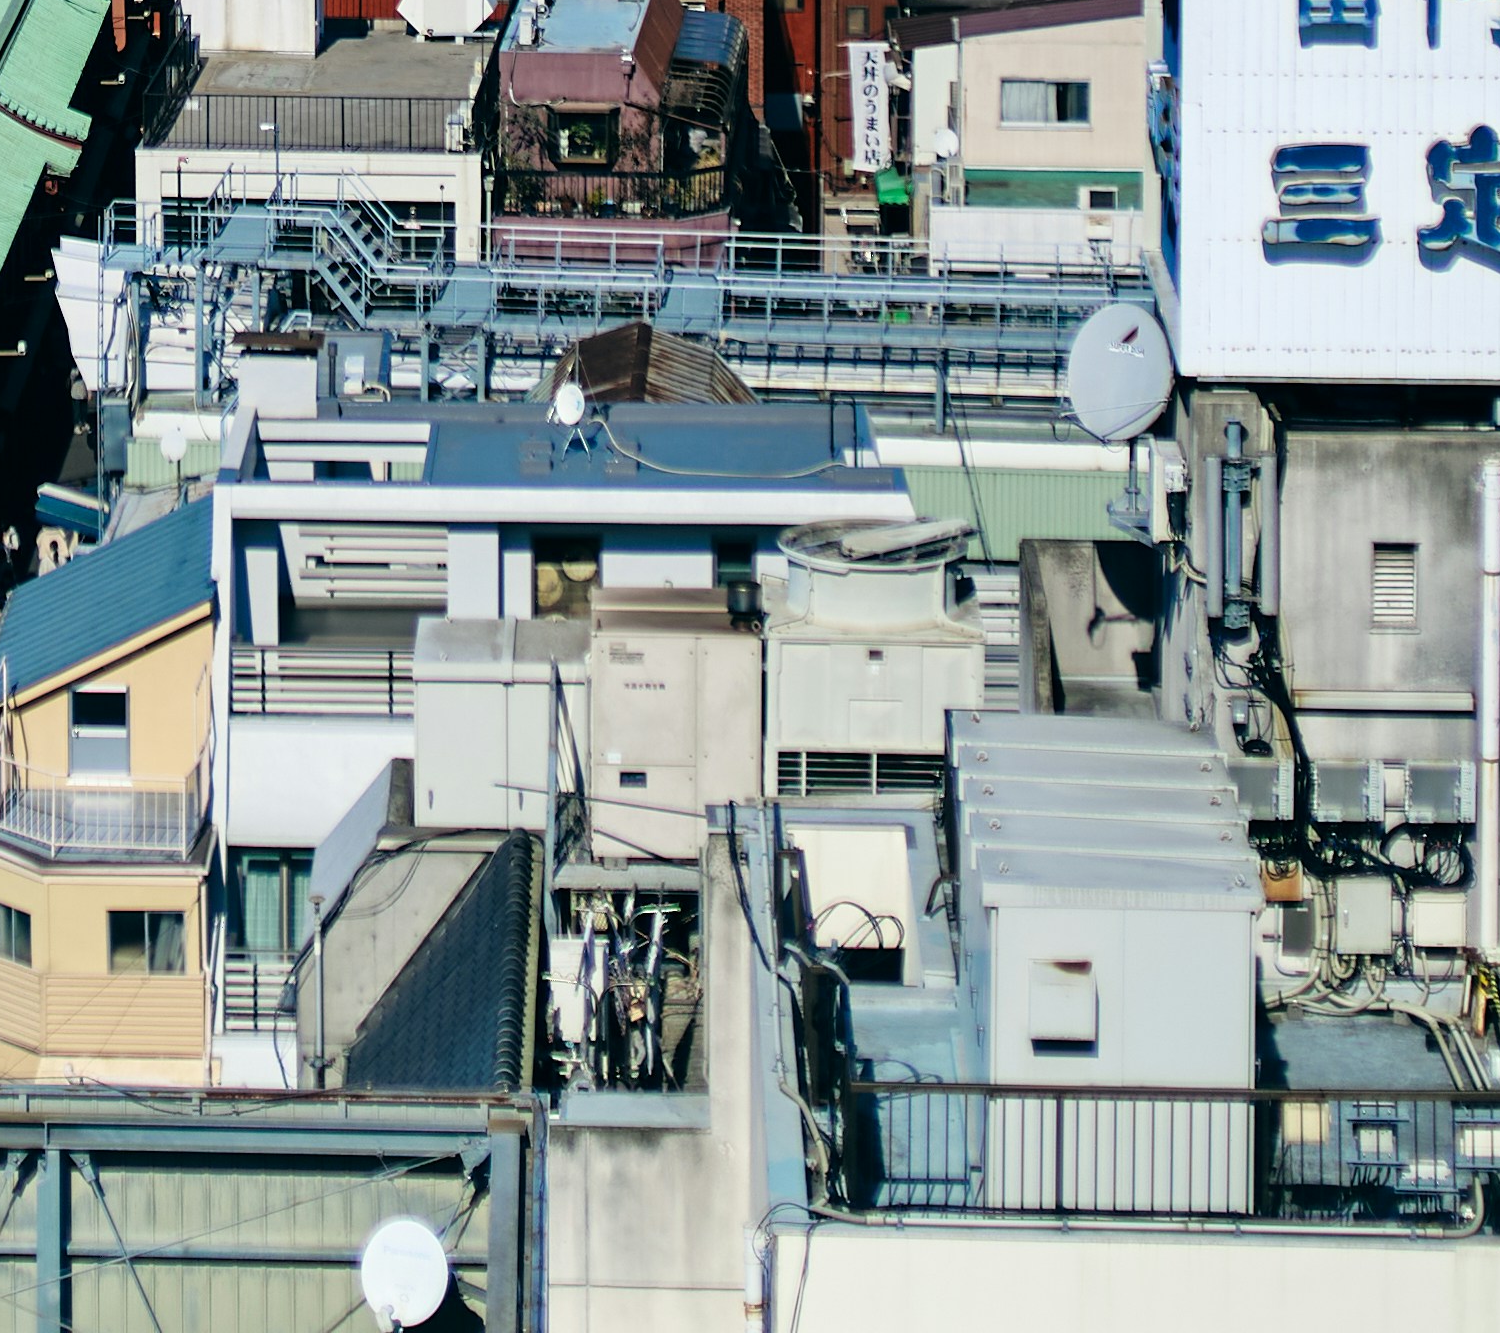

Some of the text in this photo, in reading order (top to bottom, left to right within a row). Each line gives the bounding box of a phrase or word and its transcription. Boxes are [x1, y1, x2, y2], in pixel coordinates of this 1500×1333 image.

[860, 49, 882, 167] 天丼のうまい店
